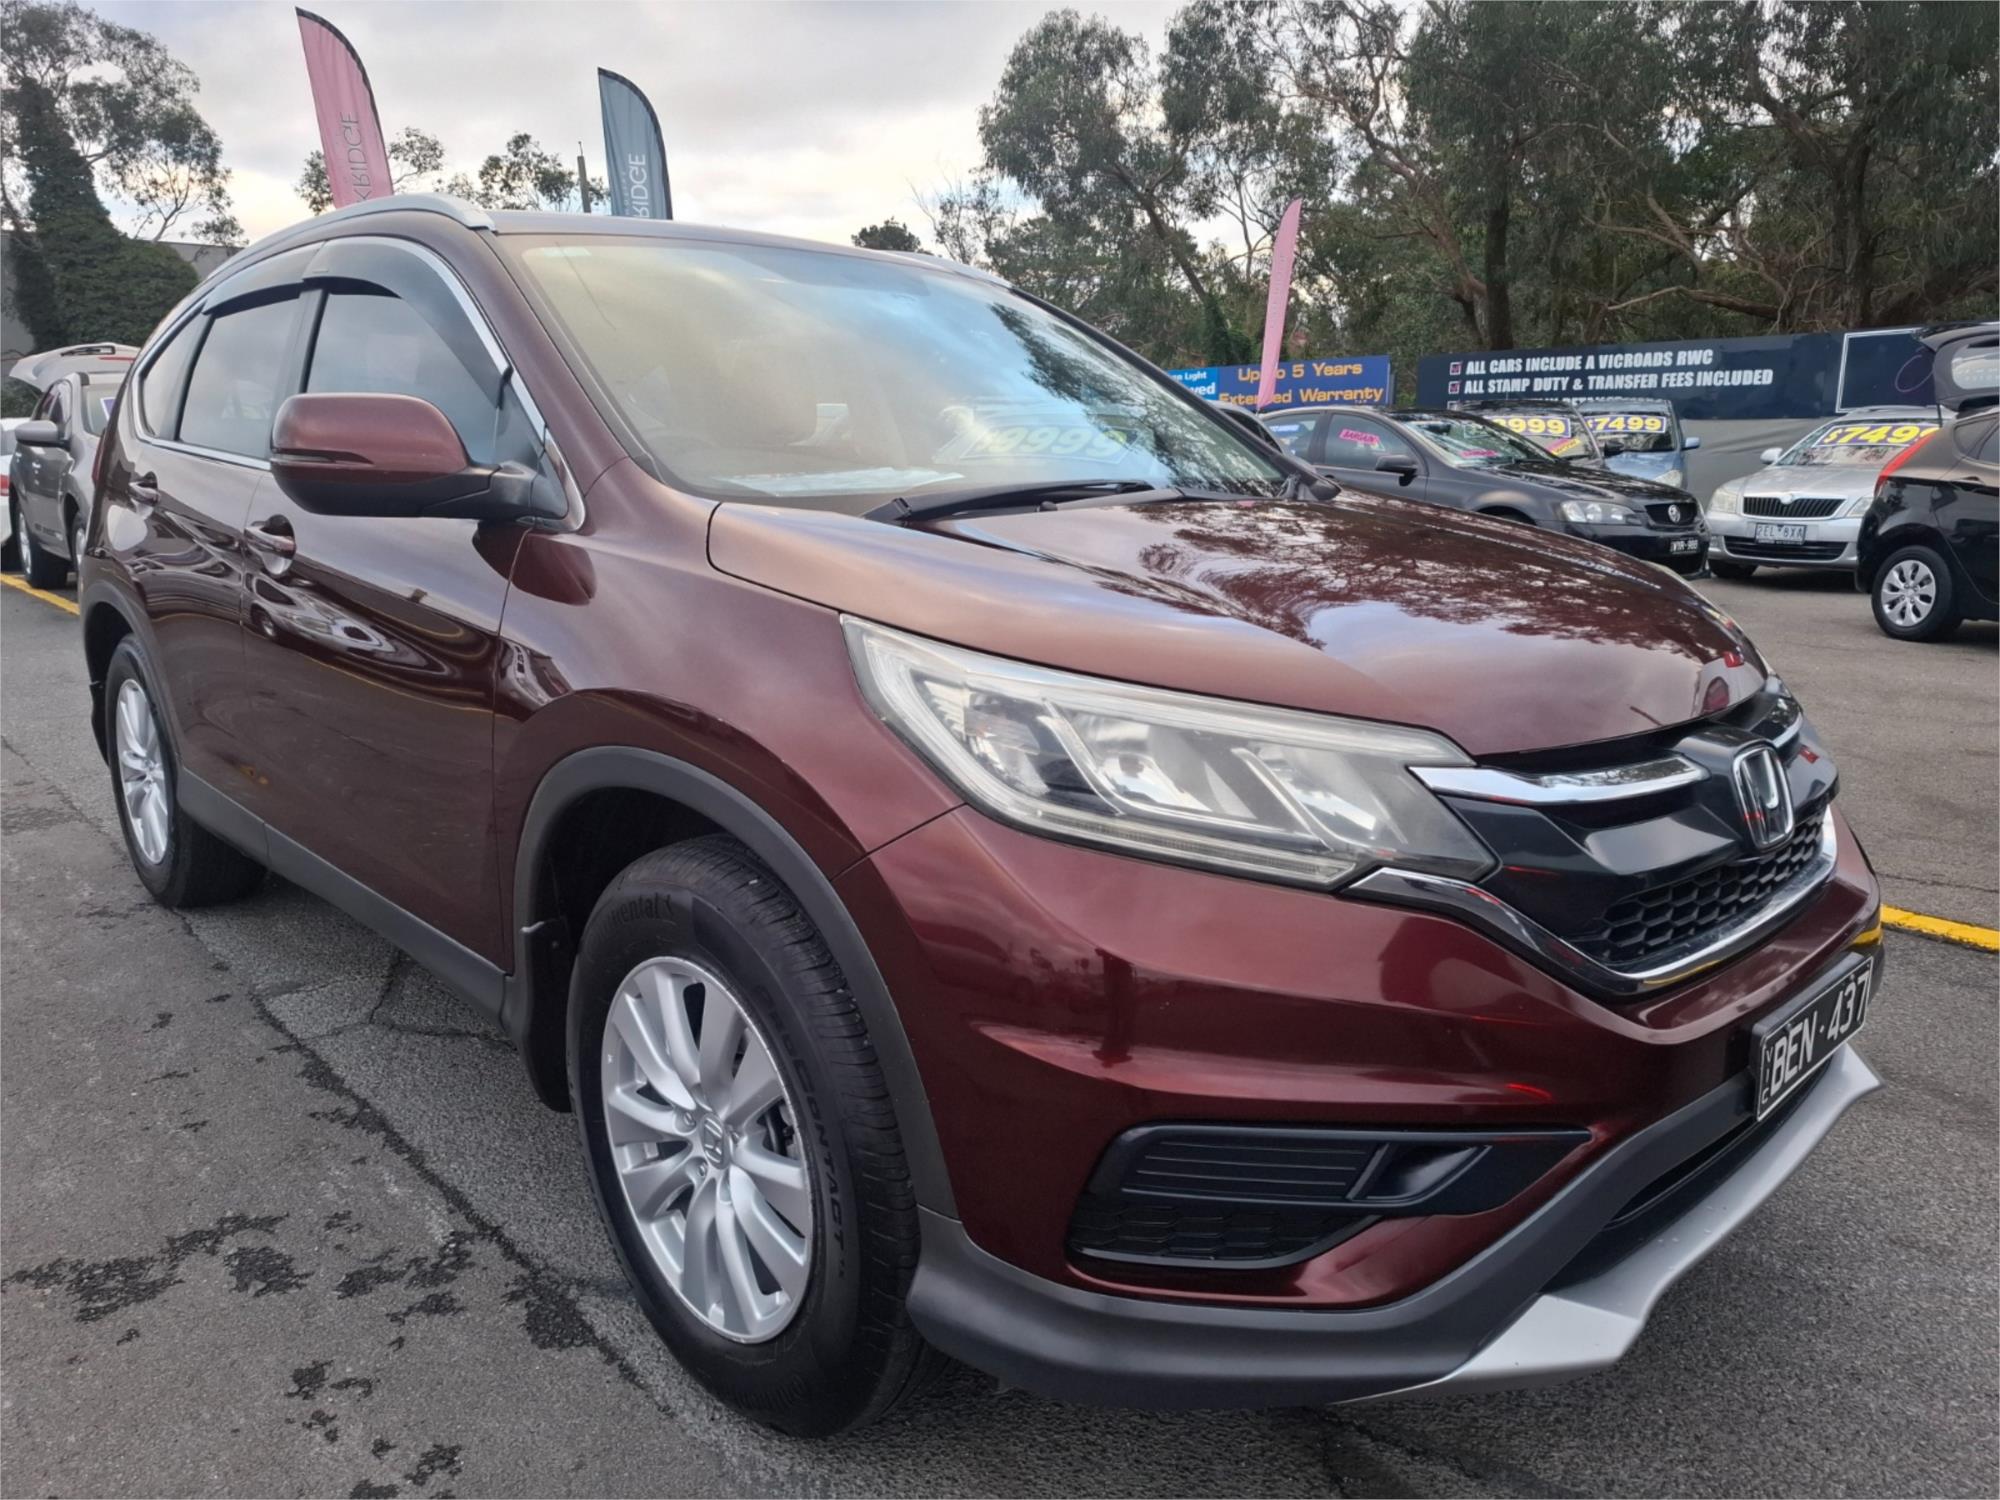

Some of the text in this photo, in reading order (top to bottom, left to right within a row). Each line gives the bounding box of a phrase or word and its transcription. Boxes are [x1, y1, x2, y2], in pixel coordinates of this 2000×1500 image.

[1238, 367, 1260, 384] Up
[1292, 364, 1304, 378] 5
[1312, 362, 1363, 377] Years
[1466, 349, 1714, 375] ALL CARS INCLUDE A VICROADS RWC
[1184, 371, 1207, 382] Light
[1464, 369, 1773, 394] ALL STAMP DUTY & TRANSFER FEES INCLUDED
[1219, 386, 1384, 405] Exteed Warranty
